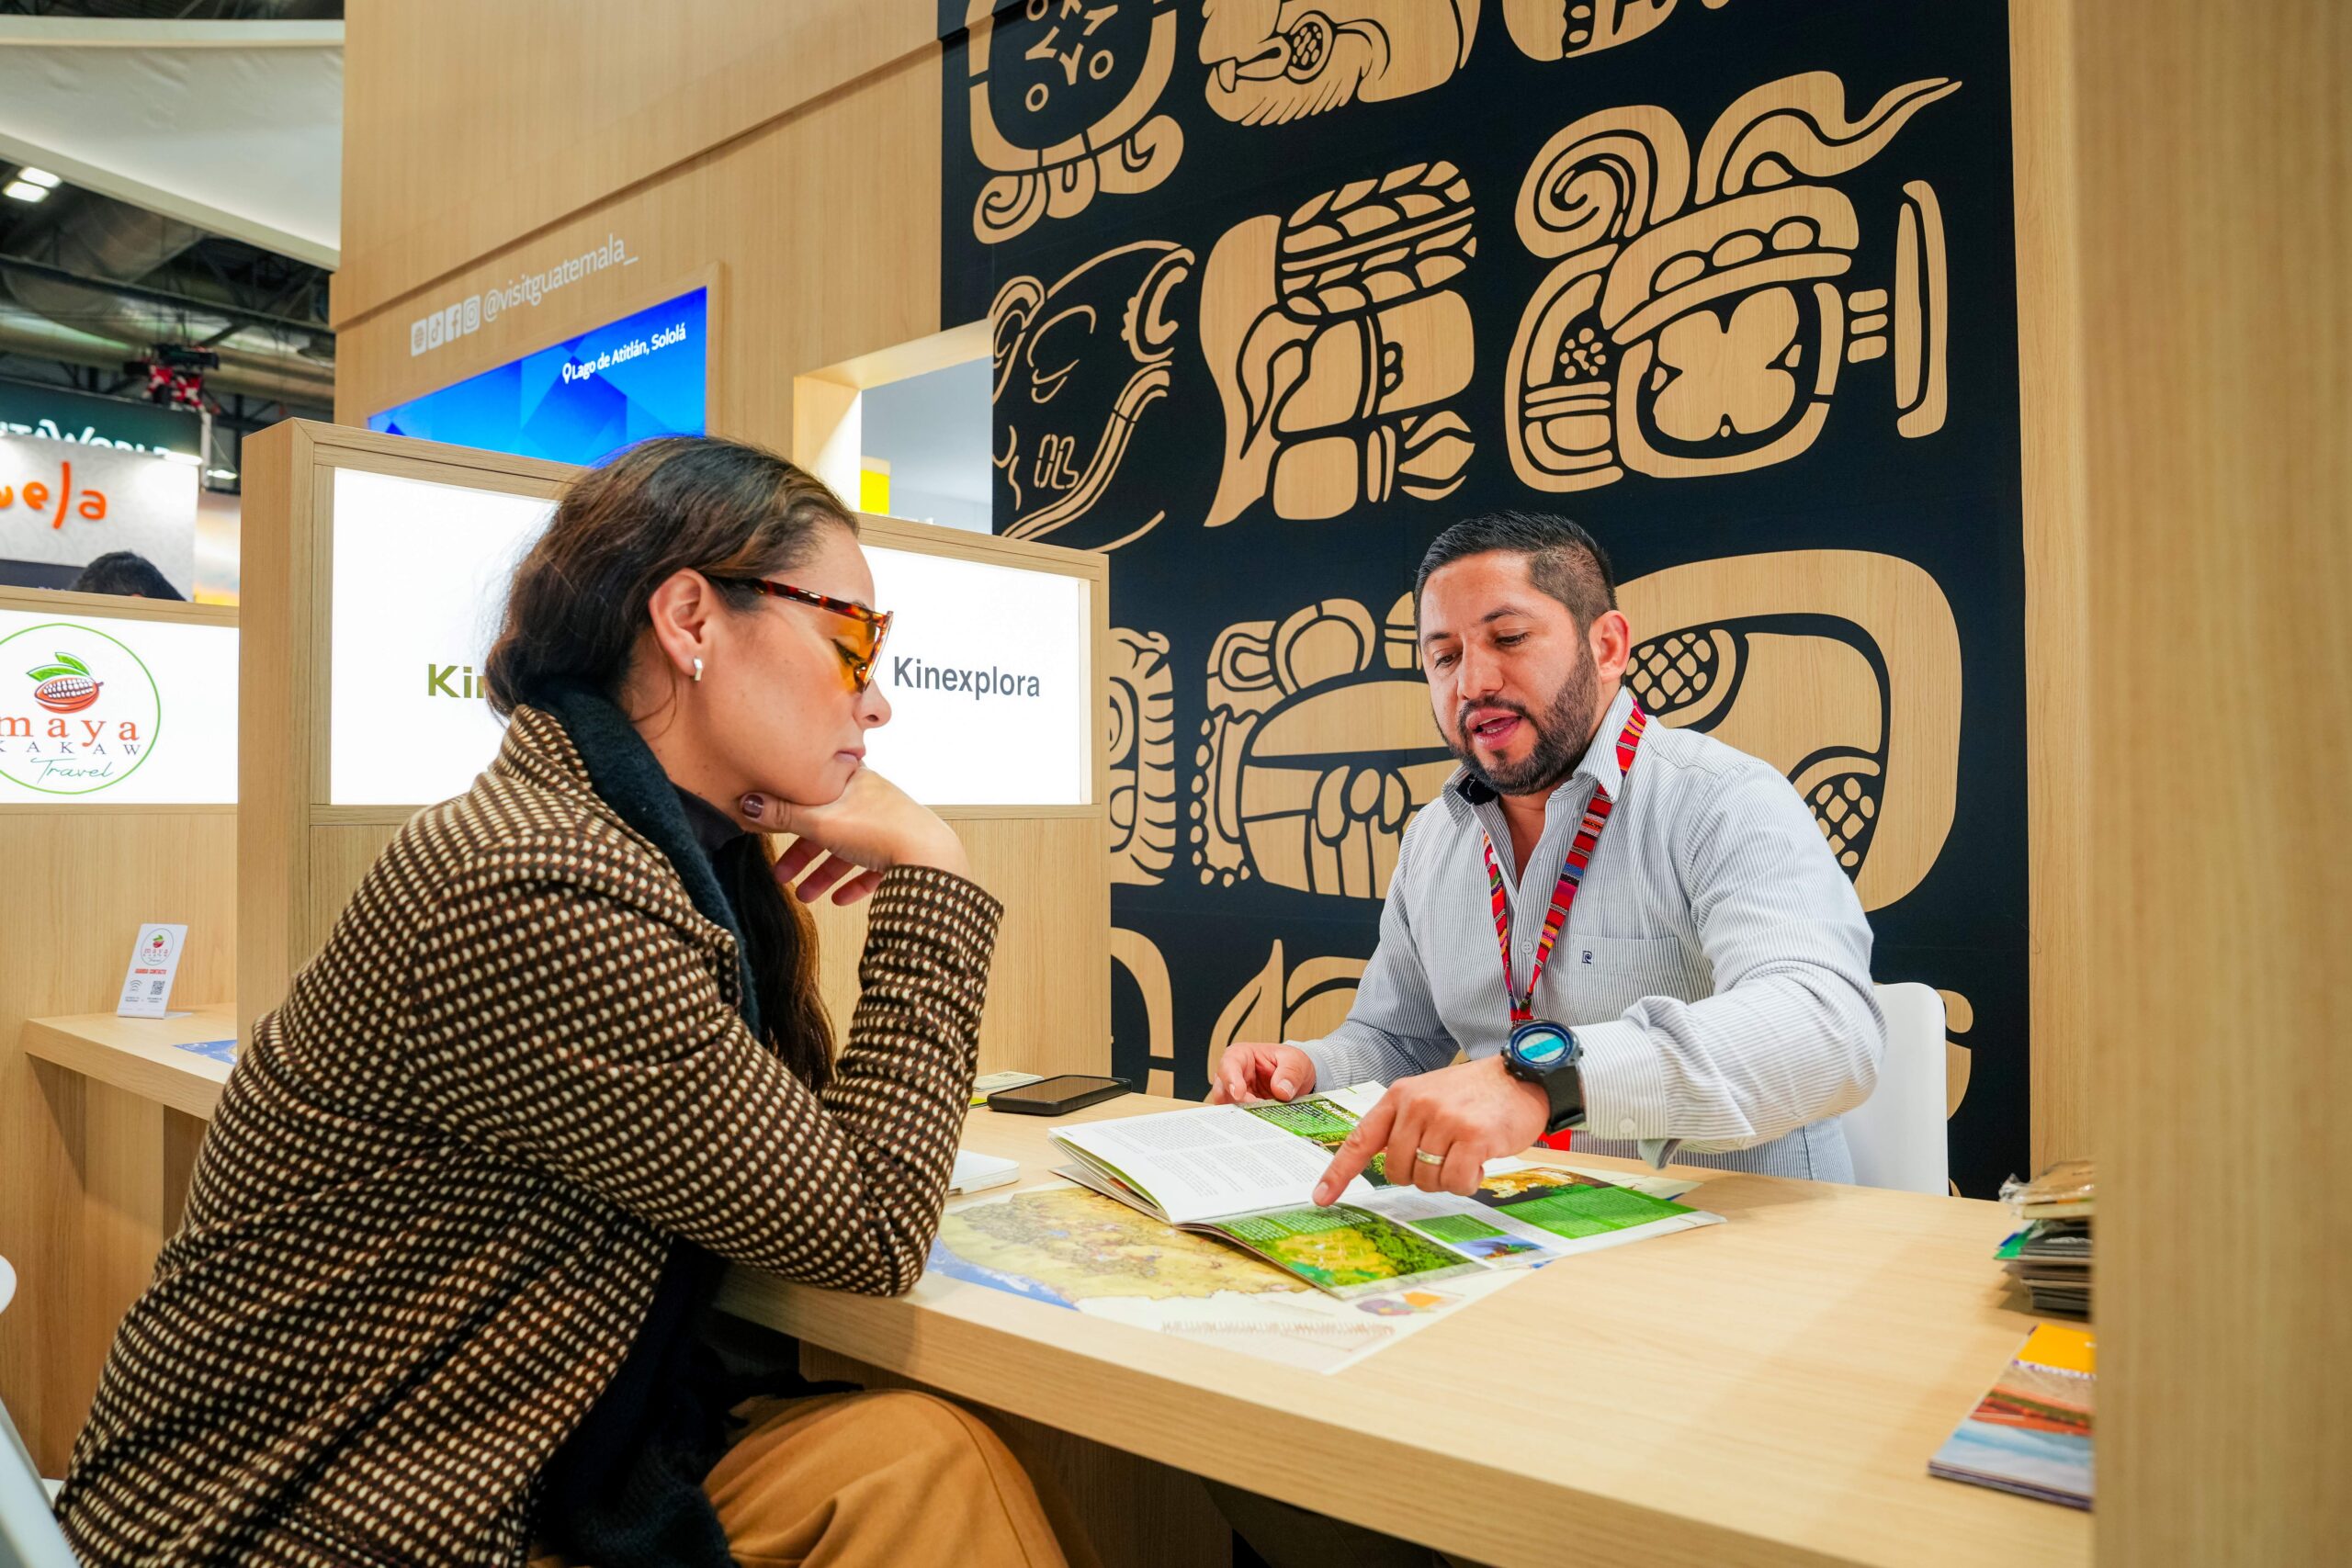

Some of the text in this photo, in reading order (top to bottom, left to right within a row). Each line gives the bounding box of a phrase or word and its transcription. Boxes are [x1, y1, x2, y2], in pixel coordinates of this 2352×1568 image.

[483, 233, 639, 322] @visitguatemala_
[571, 321, 686, 380] Lago de Atitlán, Sololá
[894, 655, 1040, 701] Kinexplora
[0, 716, 141, 748] maya
[29, 757, 115, 785] Travel
